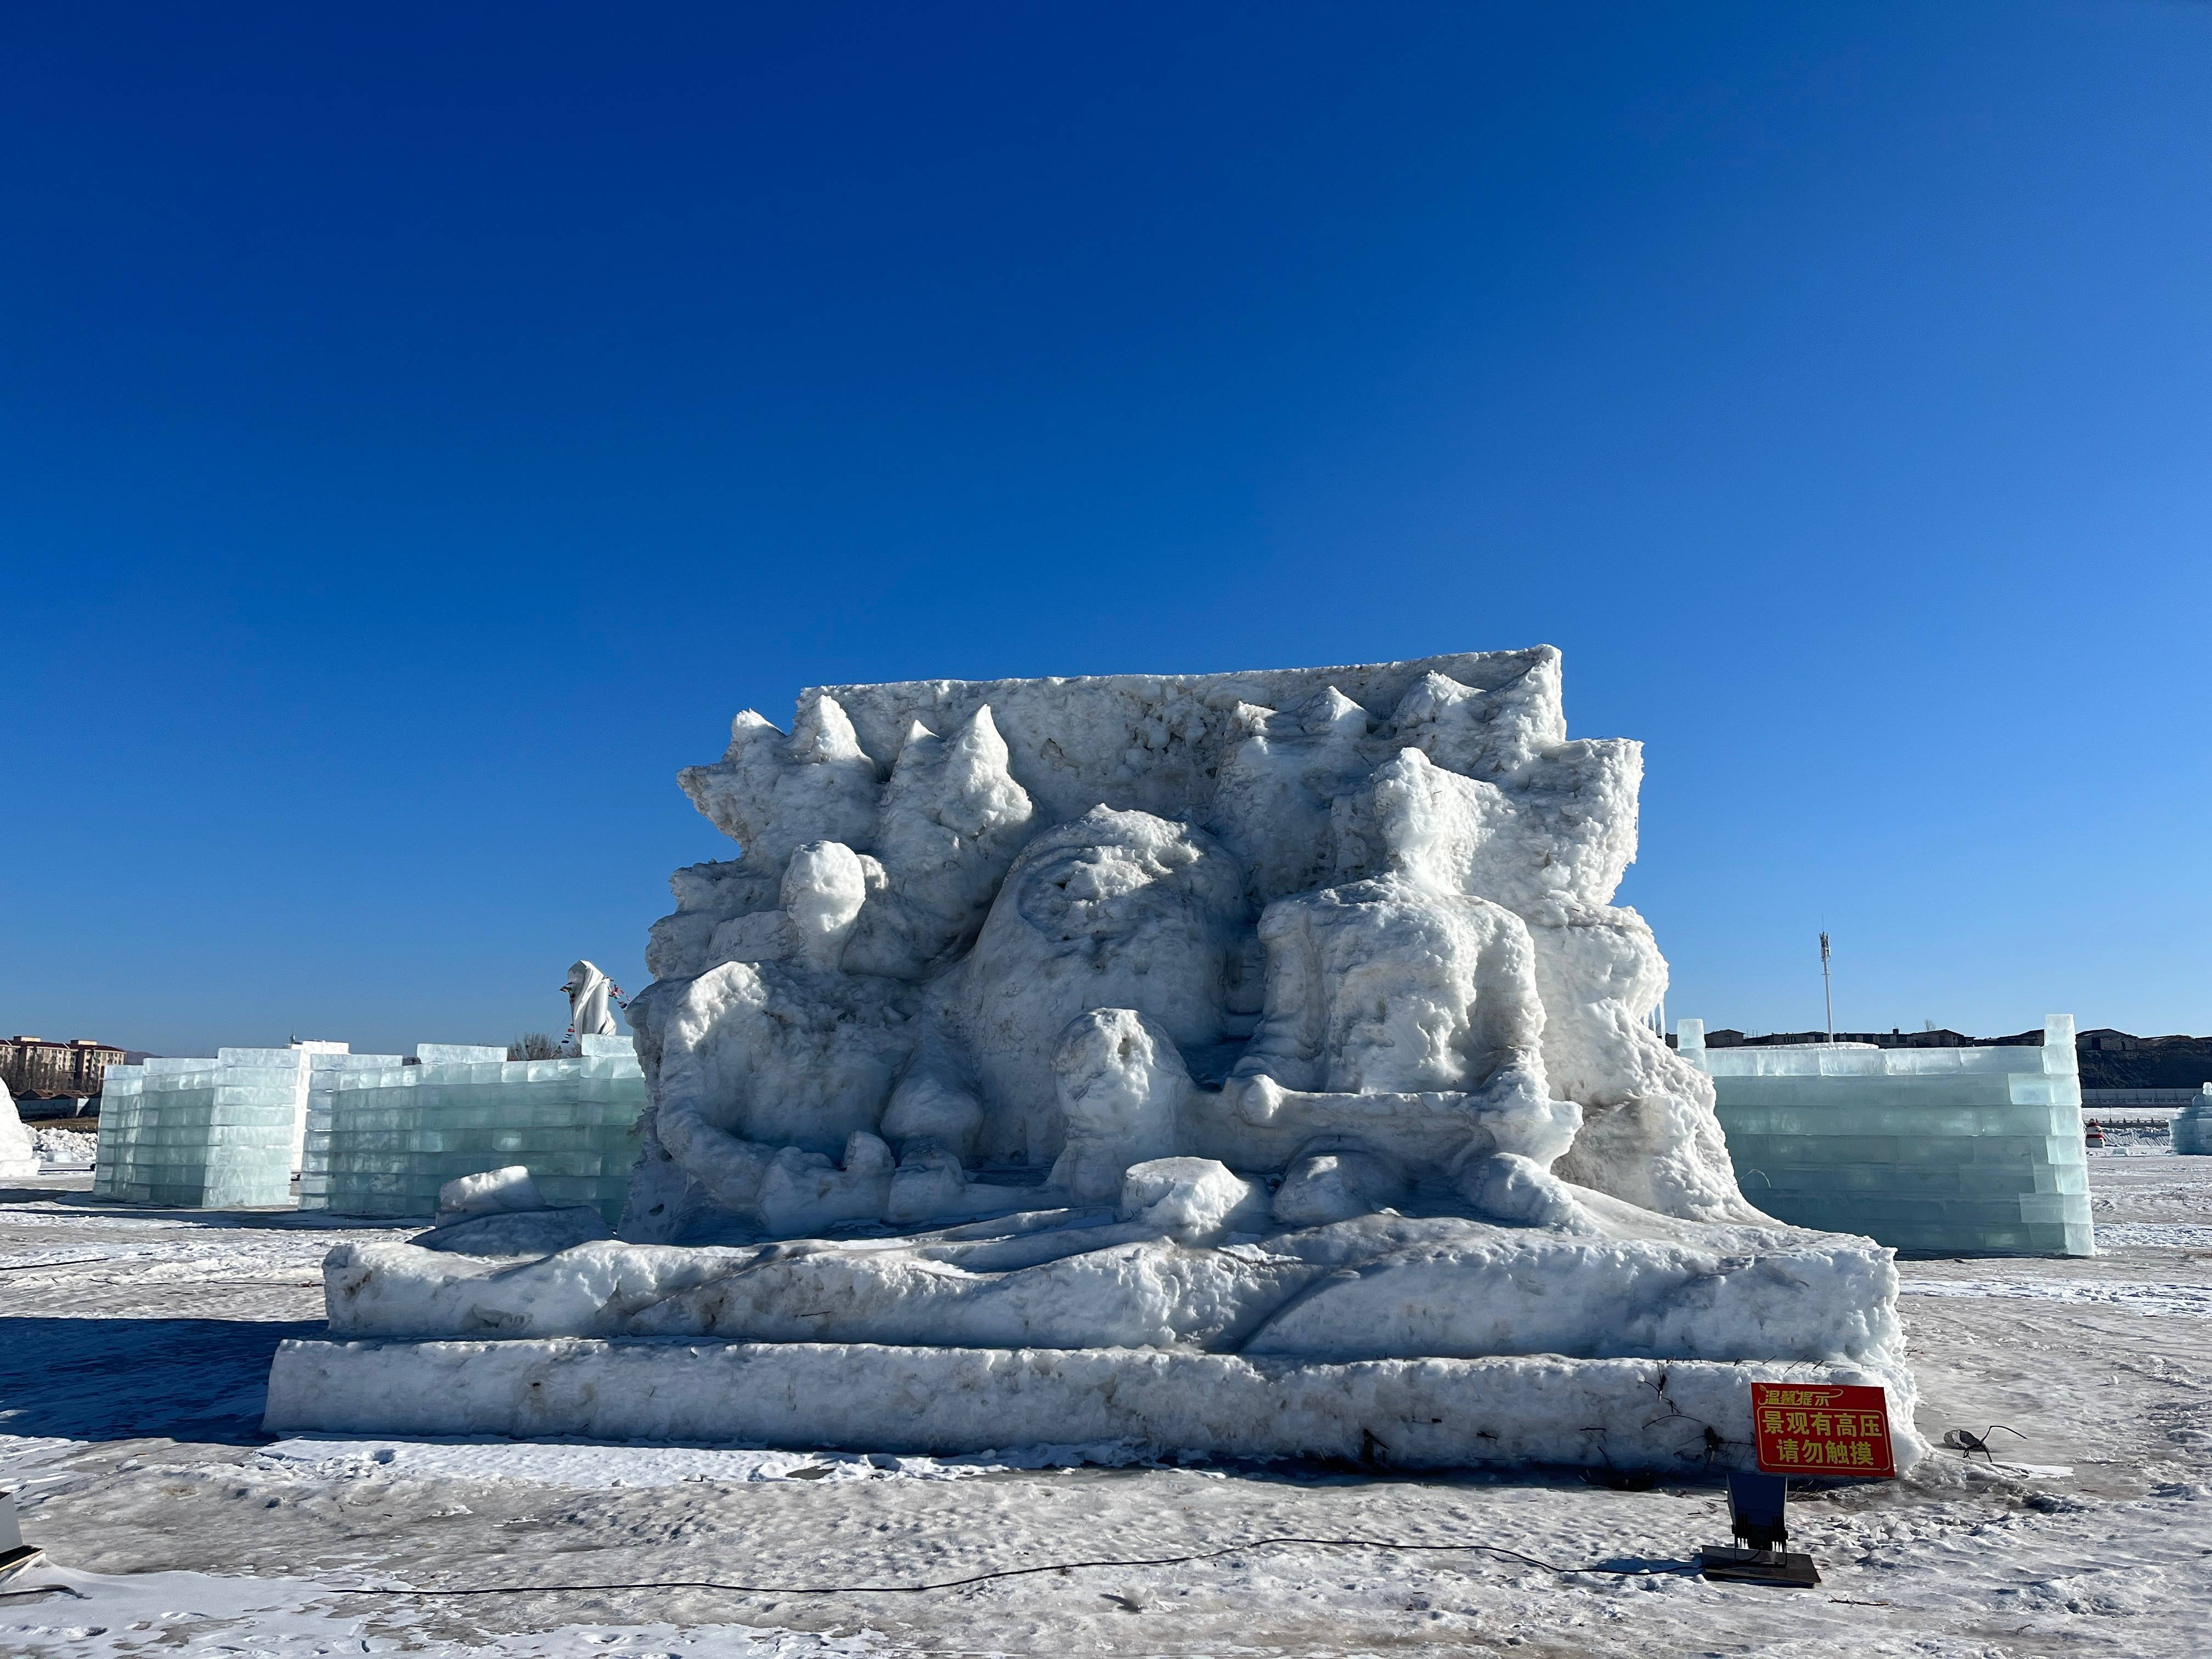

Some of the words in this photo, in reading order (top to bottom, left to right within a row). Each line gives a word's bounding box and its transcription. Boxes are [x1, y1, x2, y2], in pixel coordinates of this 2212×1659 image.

[1762, 1389, 1830, 1407] 温馨提示
[1762, 1410, 1882, 1437] 景观有高压
[1776, 1438, 1874, 1466] 请勿触摸
